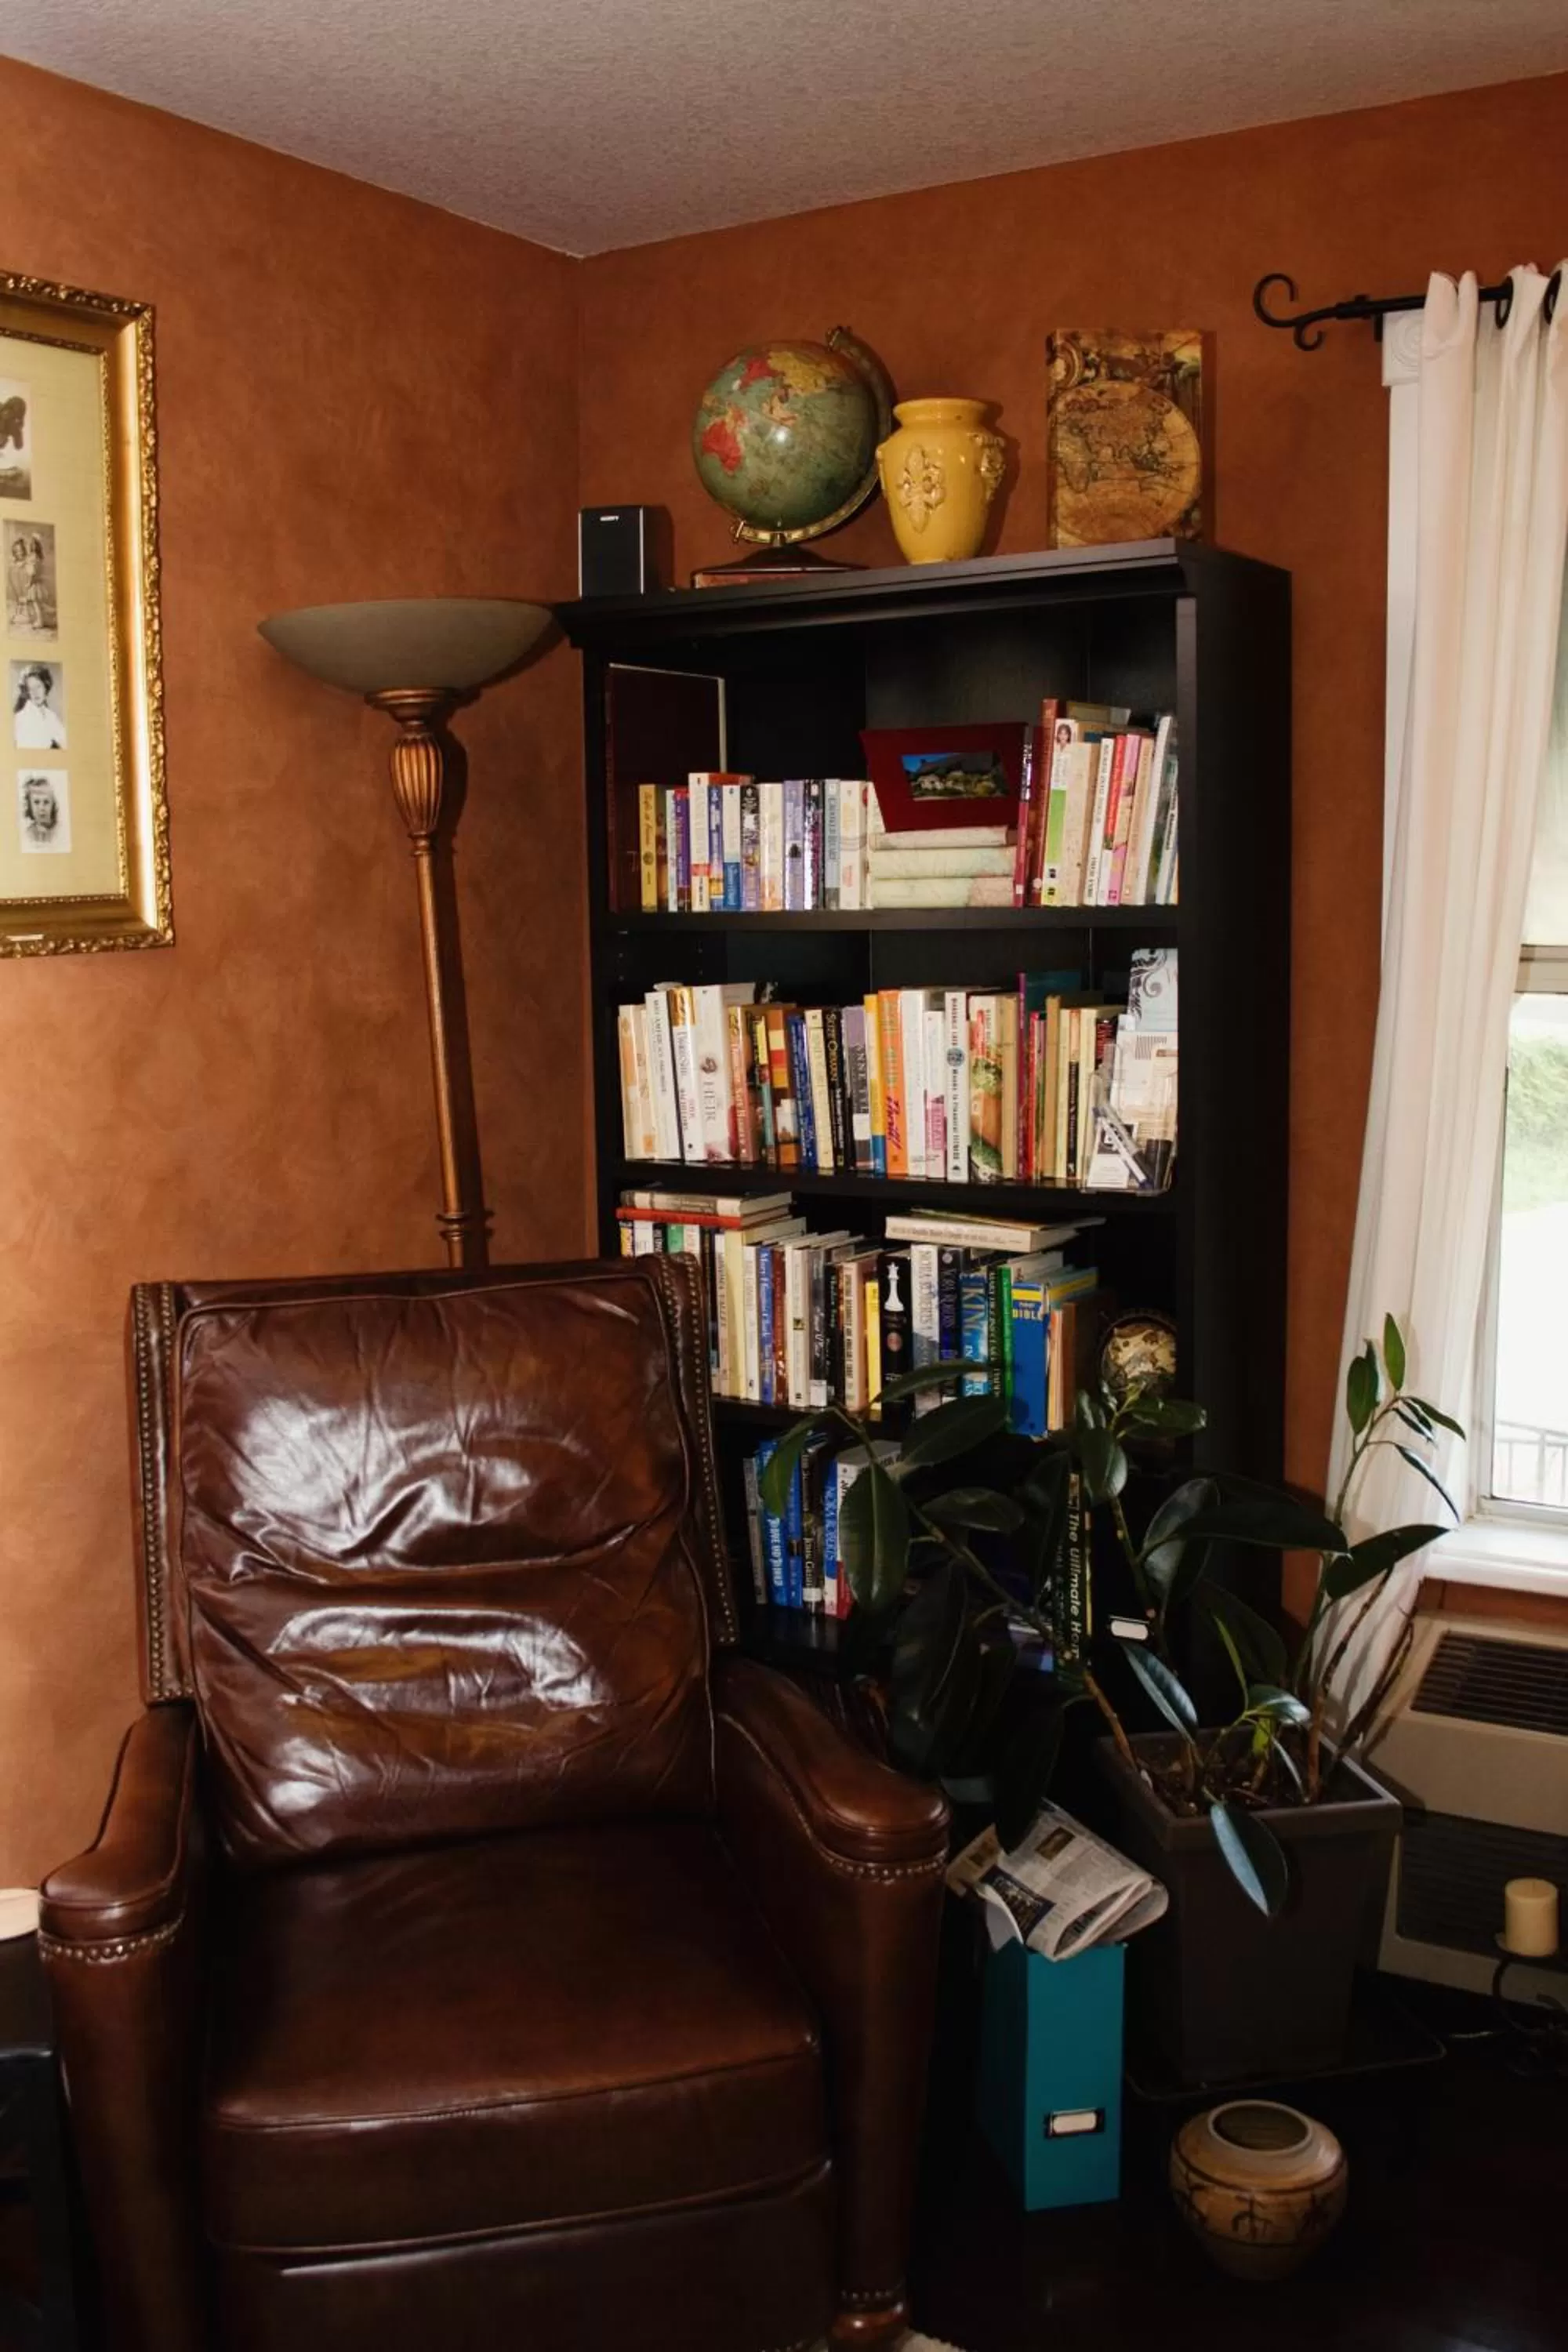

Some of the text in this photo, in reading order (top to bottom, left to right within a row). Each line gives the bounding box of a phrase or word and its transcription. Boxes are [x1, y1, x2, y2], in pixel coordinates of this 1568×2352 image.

[856, 1045, 866, 1081] ANNE
[962, 1287, 986, 1336] KING
[1069, 1514, 1080, 1542] The
[1069, 1548, 1081, 1616] Ultimate
